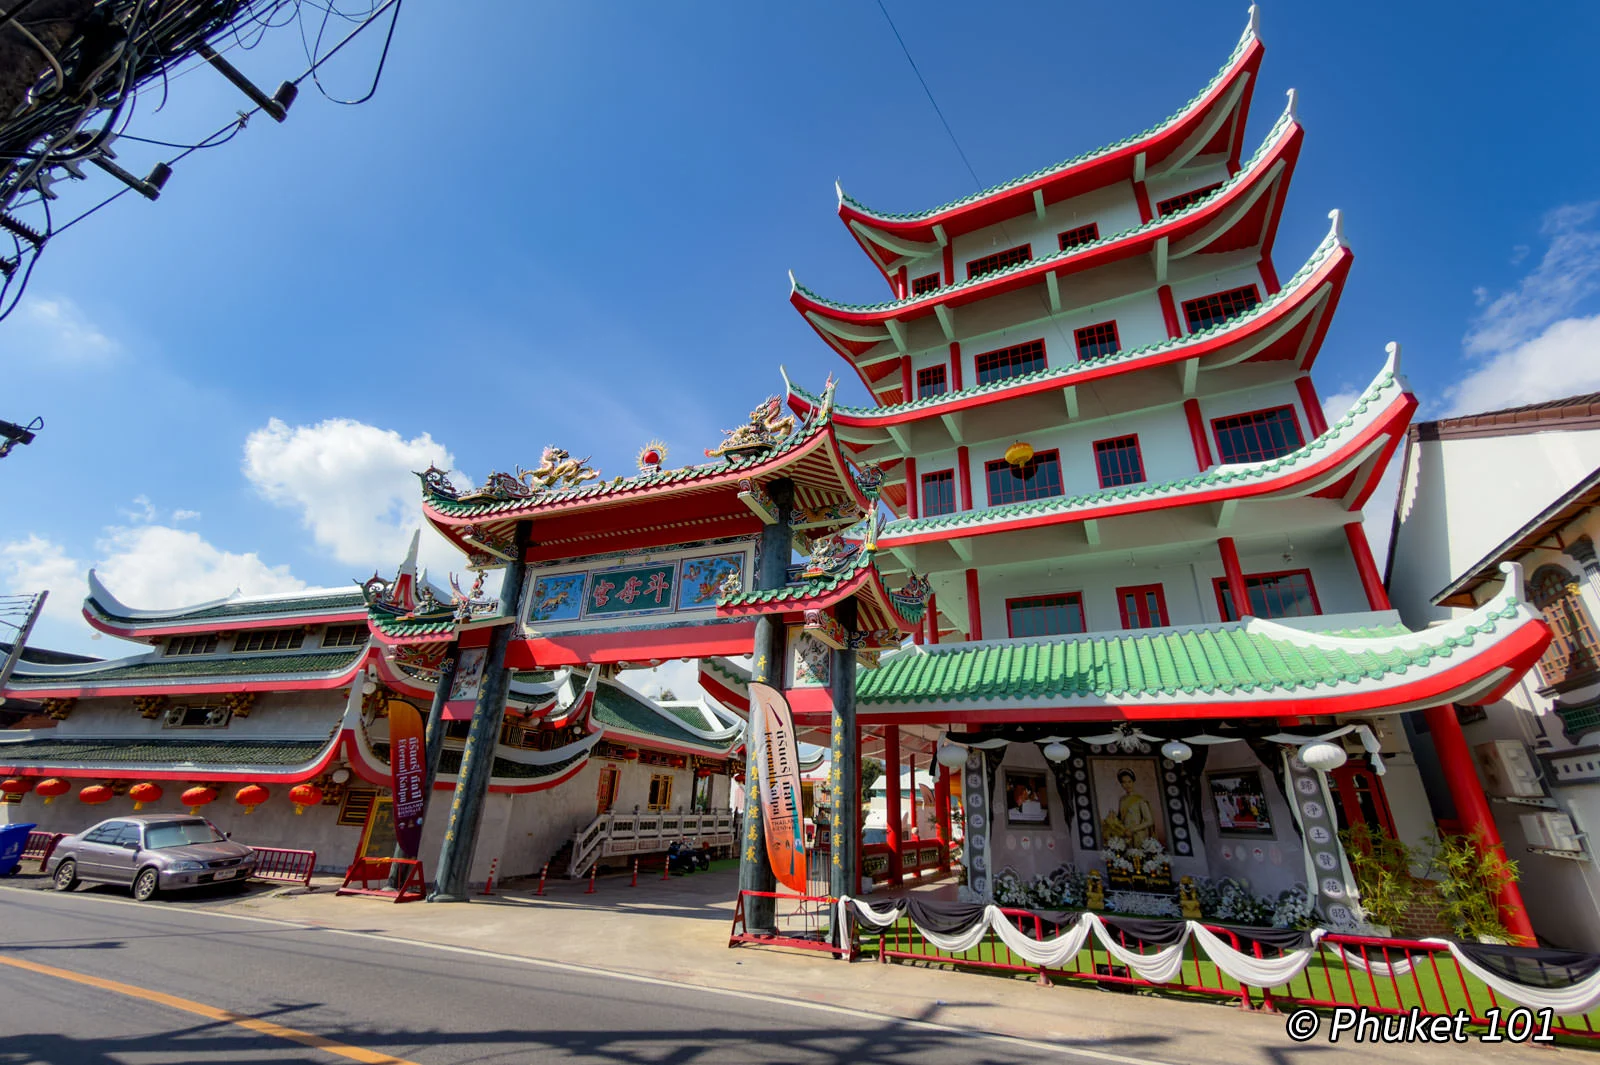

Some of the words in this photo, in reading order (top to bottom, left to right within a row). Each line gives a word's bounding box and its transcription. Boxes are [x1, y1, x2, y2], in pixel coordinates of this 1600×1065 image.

[398, 738, 408, 774] Eternal
[398, 775, 408, 803] Kalpa
[769, 780, 780, 816] Kalpa
